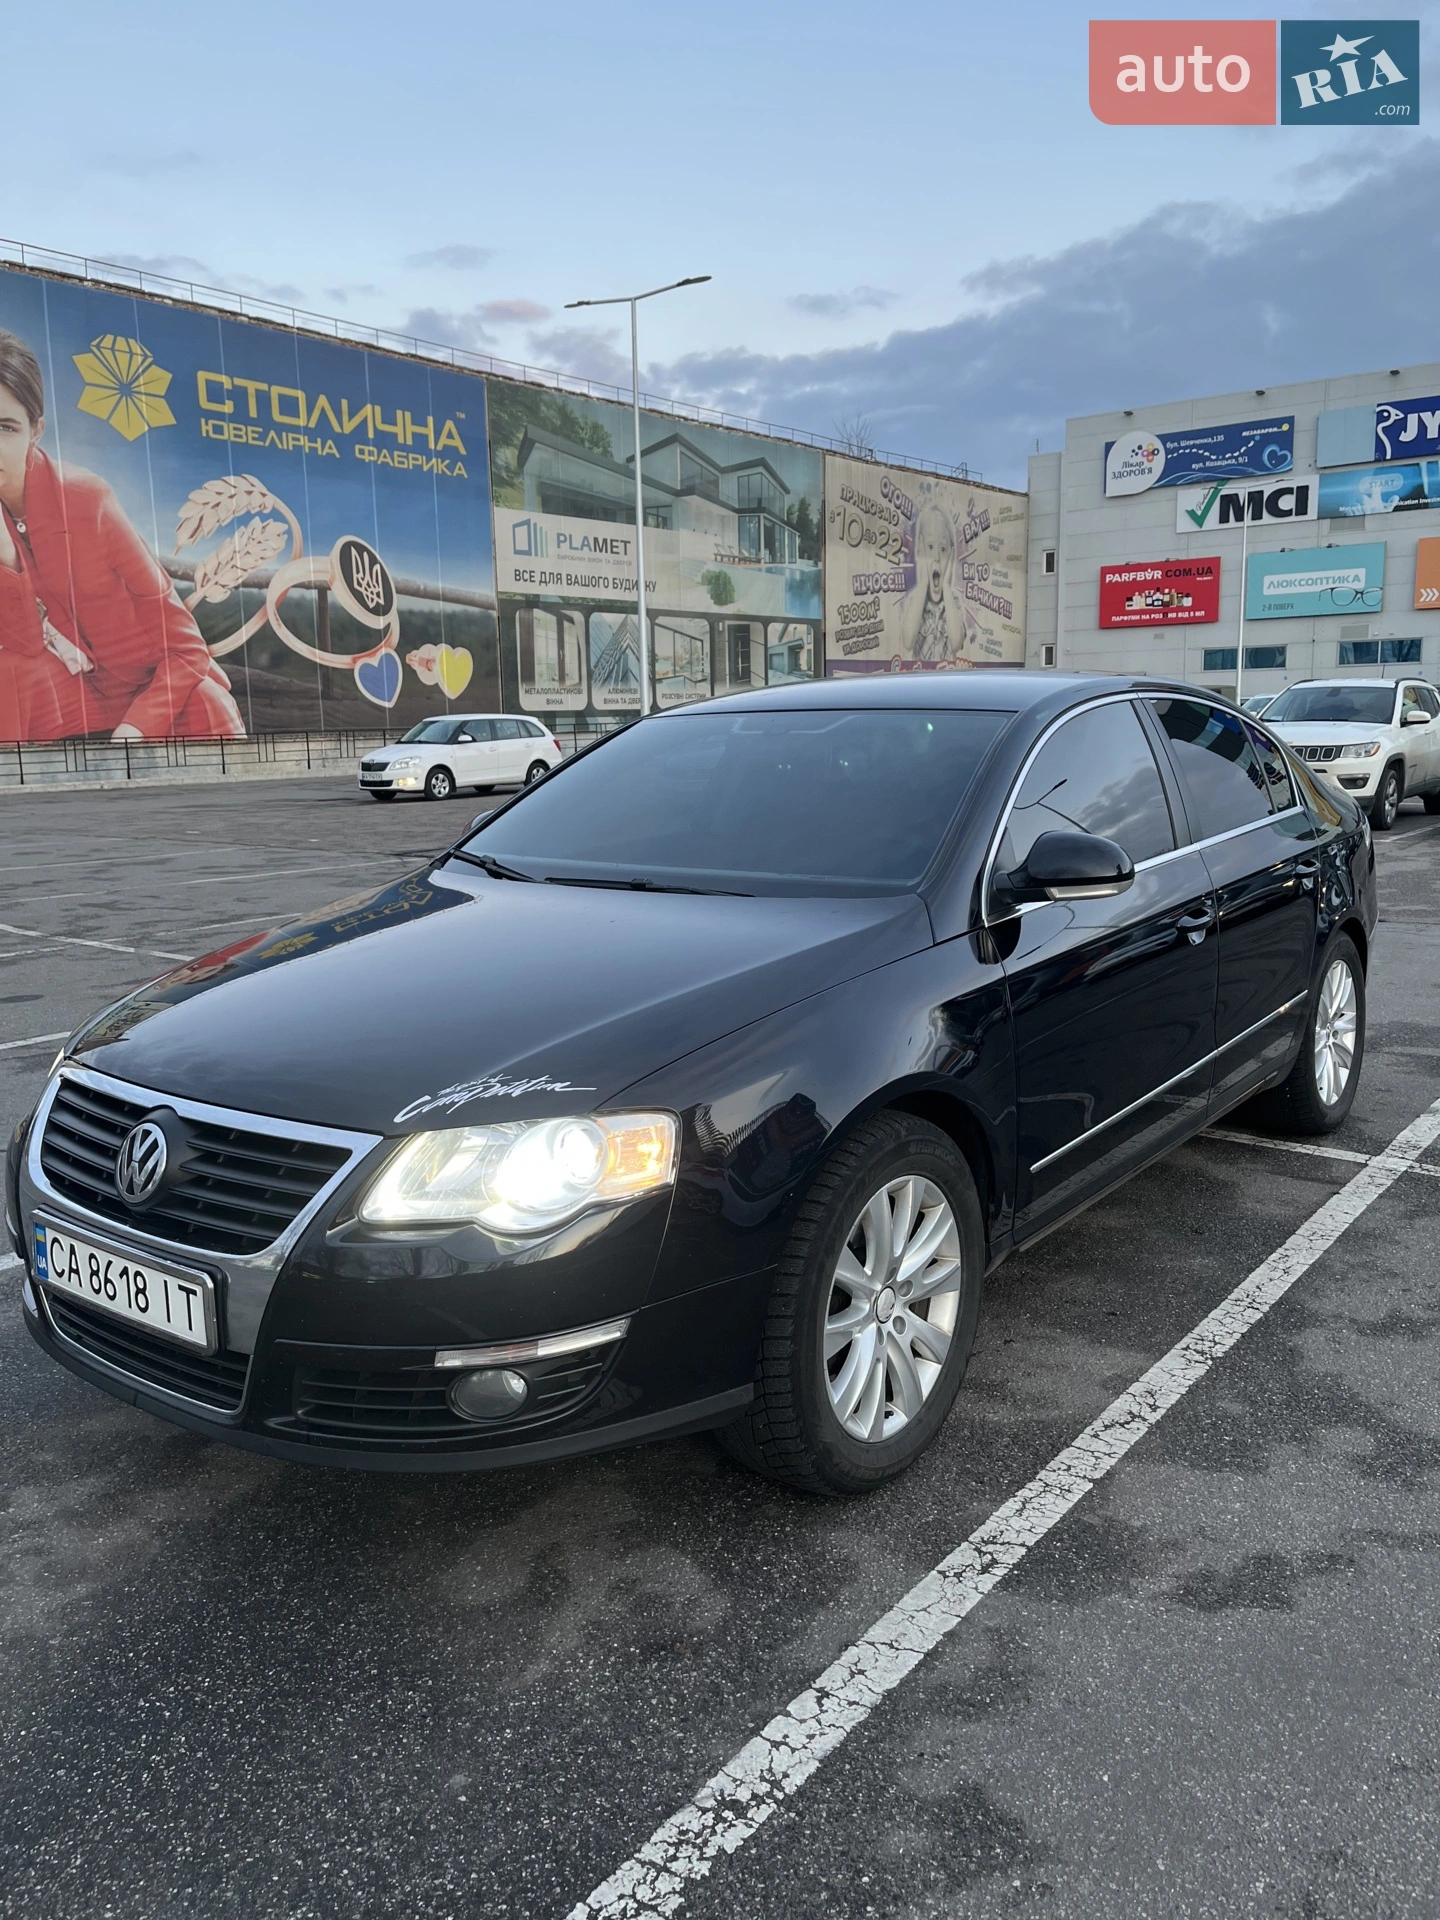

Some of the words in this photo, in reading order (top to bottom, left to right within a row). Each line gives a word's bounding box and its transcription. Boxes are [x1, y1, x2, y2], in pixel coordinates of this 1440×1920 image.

[196, 370, 467, 455] СТОЛИЧНА
[201, 418, 340, 458] ЮВЕЛІРНА
[354, 444, 468, 479] ФАБРИКА
[1166, 441, 1179, 450] бул.
[1121, 460, 1145, 470] Лікар
[1191, 462, 1205, 470] вул.
[1369, 479, 1395, 489] START
[881, 476, 913, 521] ОГО!!!
[1219, 485, 1310, 524] MCI
[556, 532, 631, 556] PLAMET
[836, 505, 864, 548] 10
[875, 525, 903, 566] 22
[514, 568, 536, 583] ВСЕ
[539, 571, 563, 587] ДЛЯ
[566, 573, 610, 589] ВАШОГО
[612, 577, 657, 593] БУДИКУ
[962, 562, 975, 580] ВИ
[976, 563, 990, 582] ТО
[1267, 574, 1361, 589] ЛЮКСОПТИКА
[1273, 602, 1294, 611] ПОВЕРХ
[524, 687, 583, 695] МЕТАЛОПЛАСТИКОВІ
[546, 697, 564, 705] ВІКНА
[603, 697, 620, 705] ВІКНА
[37, 1254, 47, 1271] UA
[50, 1236, 83, 1288] CA
[88, 1252, 149, 1314] 8618
[163, 1279, 198, 1332] IT
